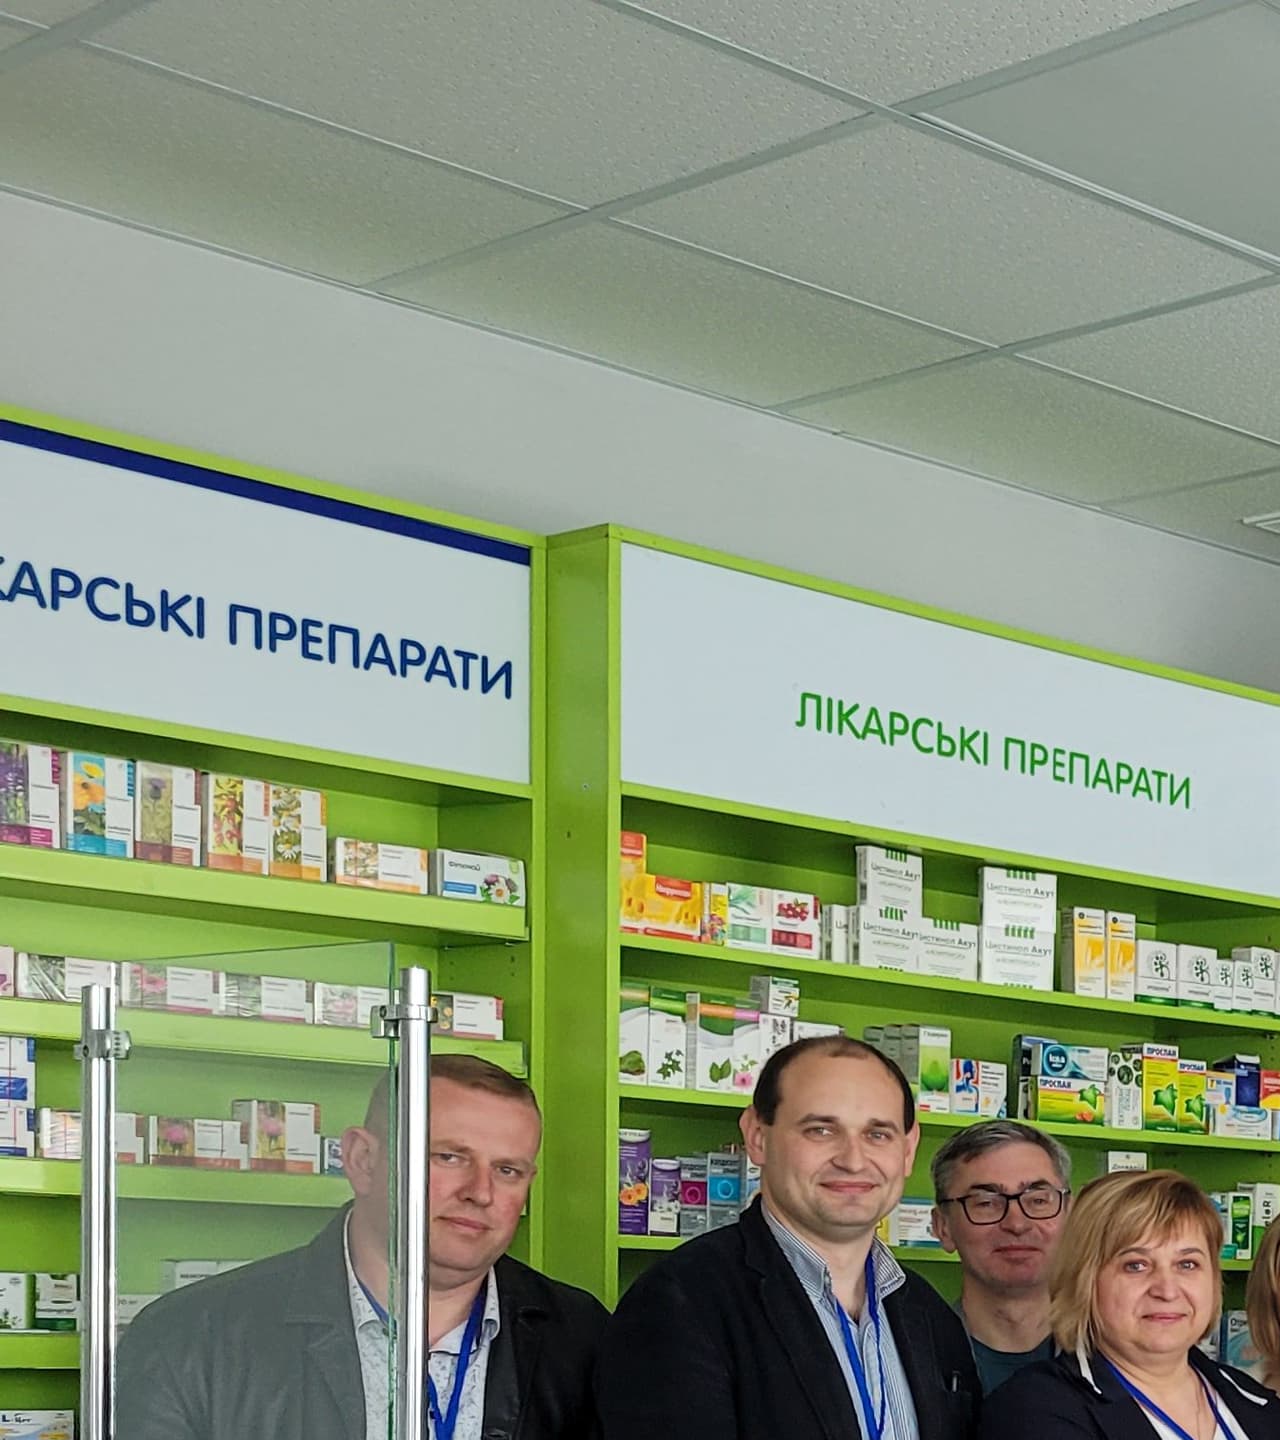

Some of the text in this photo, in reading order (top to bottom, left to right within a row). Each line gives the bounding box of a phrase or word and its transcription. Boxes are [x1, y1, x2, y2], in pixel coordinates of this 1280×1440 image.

[228, 603, 514, 700] ПРЕПАРАТИ
[795, 692, 1193, 810] ЛІКАРСЬКІ ПРЕПАРАТИ
